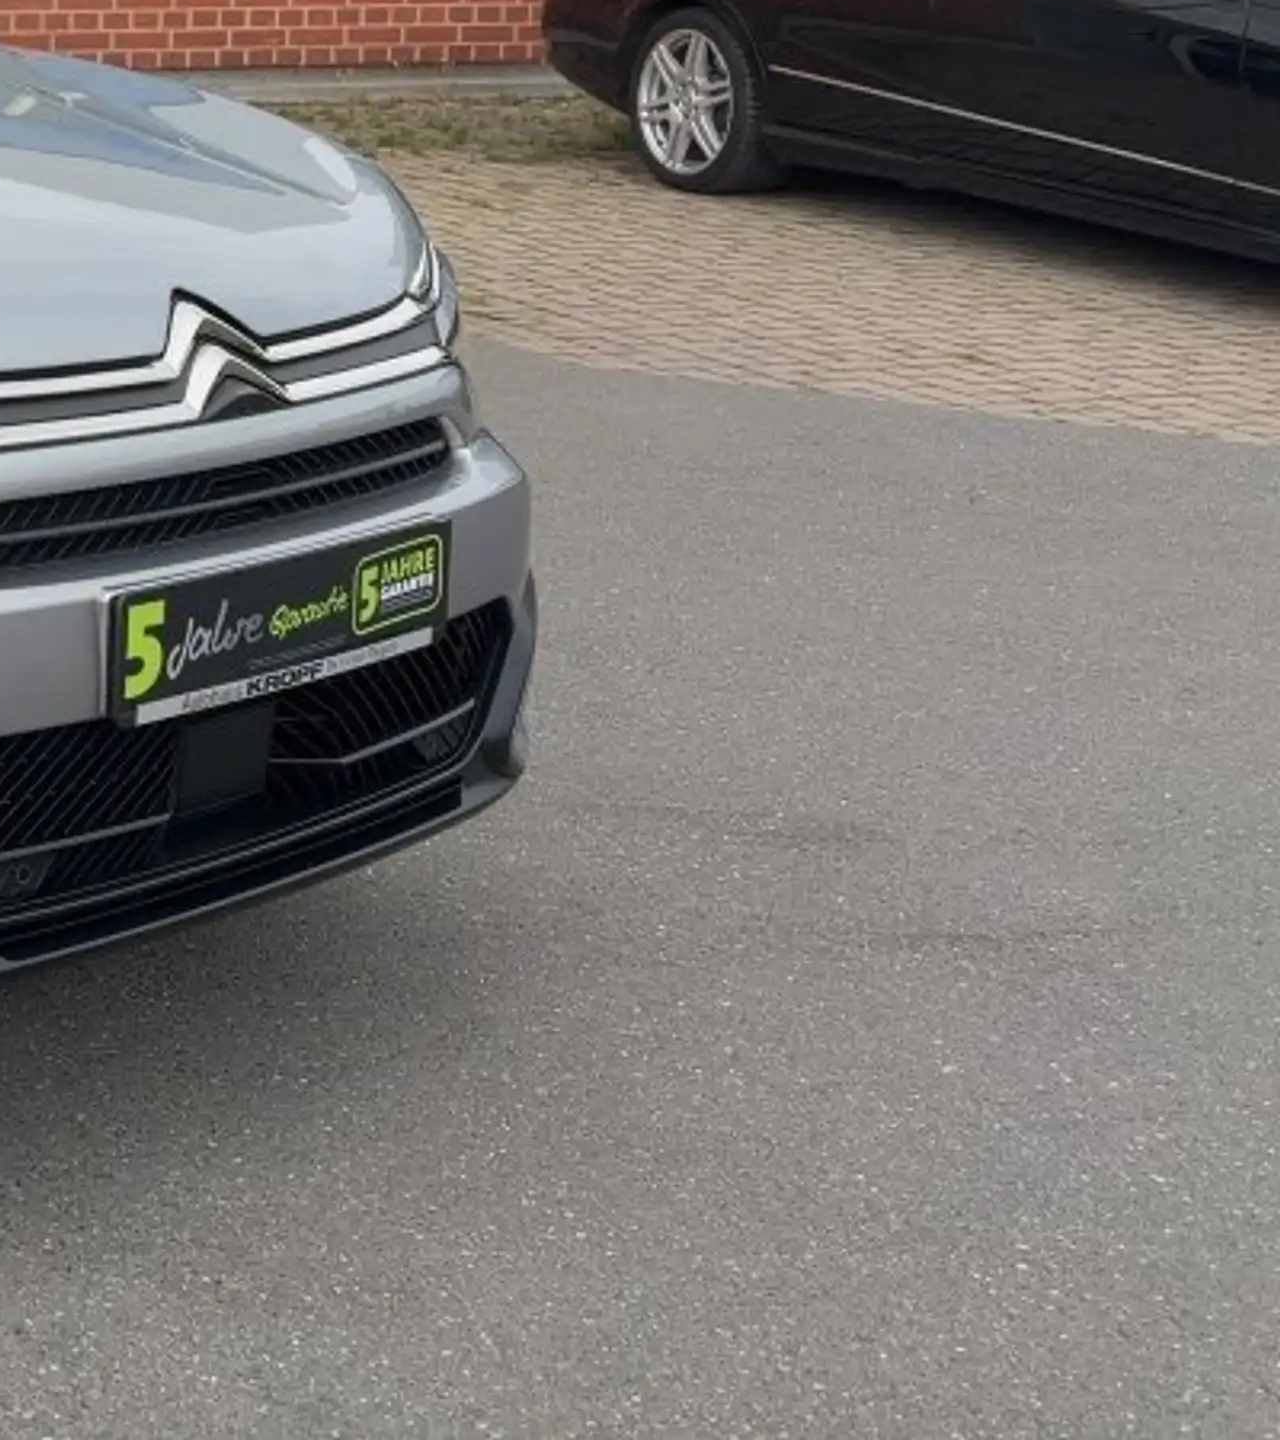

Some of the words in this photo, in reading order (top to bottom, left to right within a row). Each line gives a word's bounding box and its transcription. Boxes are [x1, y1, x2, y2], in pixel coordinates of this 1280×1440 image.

[359, 566, 380, 624] 5
[382, 546, 436, 581] JAHRE
[124, 599, 165, 699] 5
[245, 659, 324, 696] KROPF
